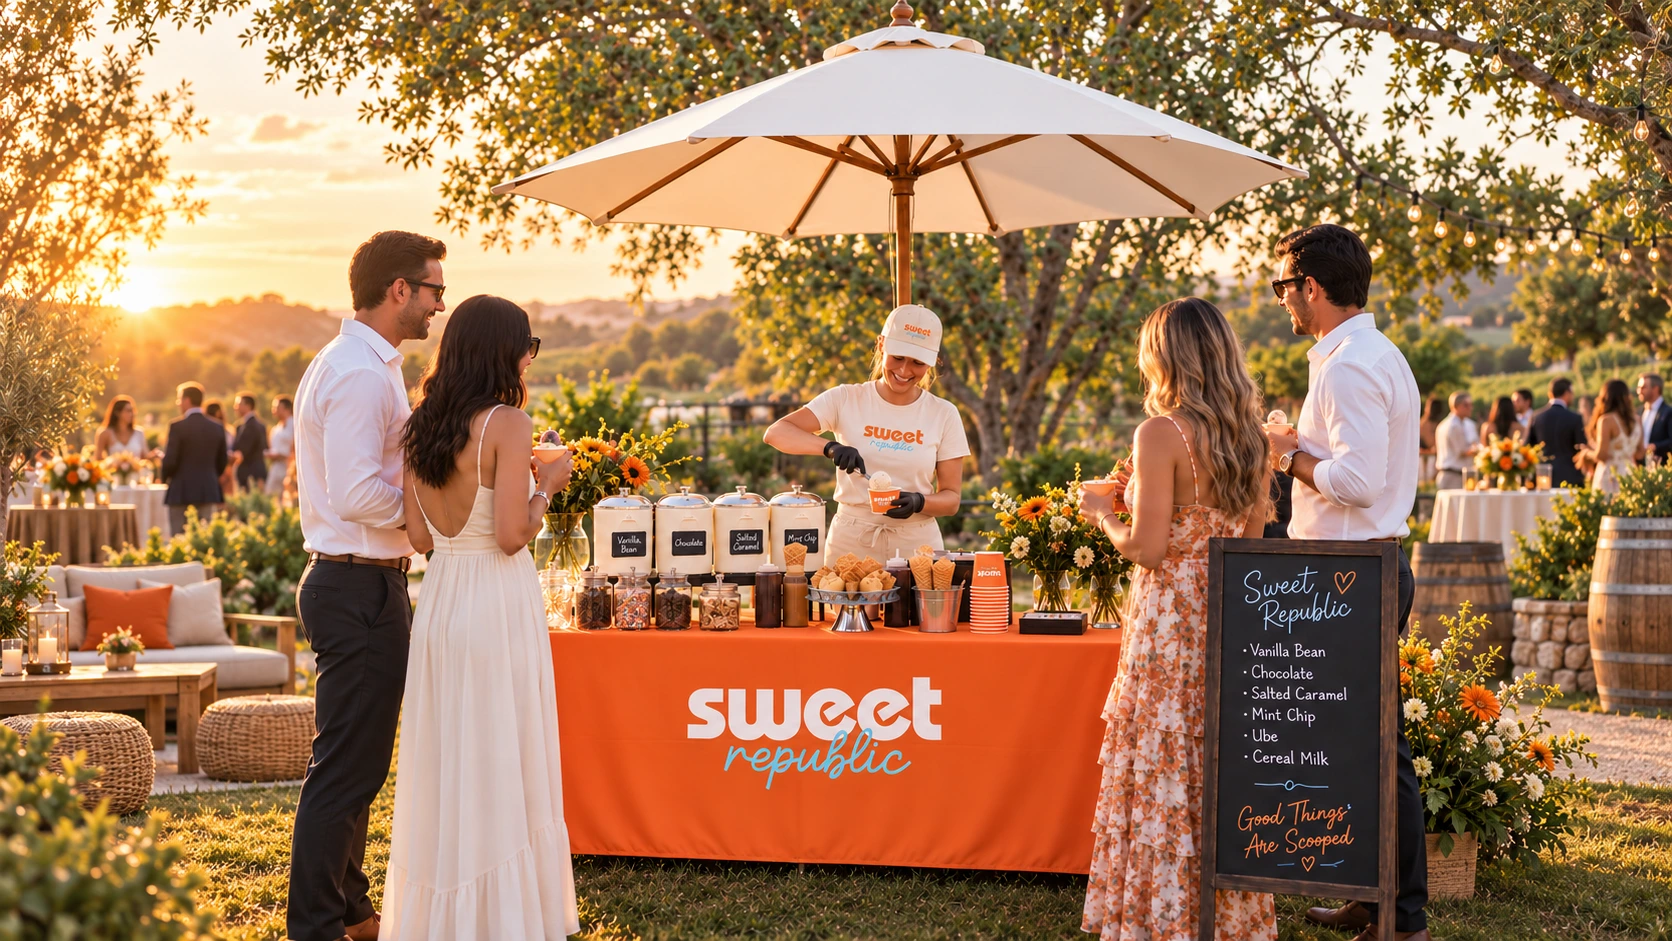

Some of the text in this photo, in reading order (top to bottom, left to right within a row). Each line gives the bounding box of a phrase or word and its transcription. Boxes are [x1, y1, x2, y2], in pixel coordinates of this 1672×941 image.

[904, 323, 931, 337] sweet
[863, 425, 924, 445] sweet
[1243, 566, 1318, 604] Sweet
[1258, 592, 1352, 634] Republic
[1250, 642, 1326, 658] Vanilla Bean
[1251, 664, 1314, 680] Chocolate
[1251, 685, 1347, 701] Salted Caramel
[687, 677, 942, 741] sweet
[1252, 707, 1316, 727] Mint Chip
[1252, 728, 1279, 743] Ube
[724, 728, 911, 790] republic
[1252, 749, 1329, 766] Cereal Milk
[1237, 799, 1348, 831] Good Things
[1244, 824, 1354, 859] Are Scooped
